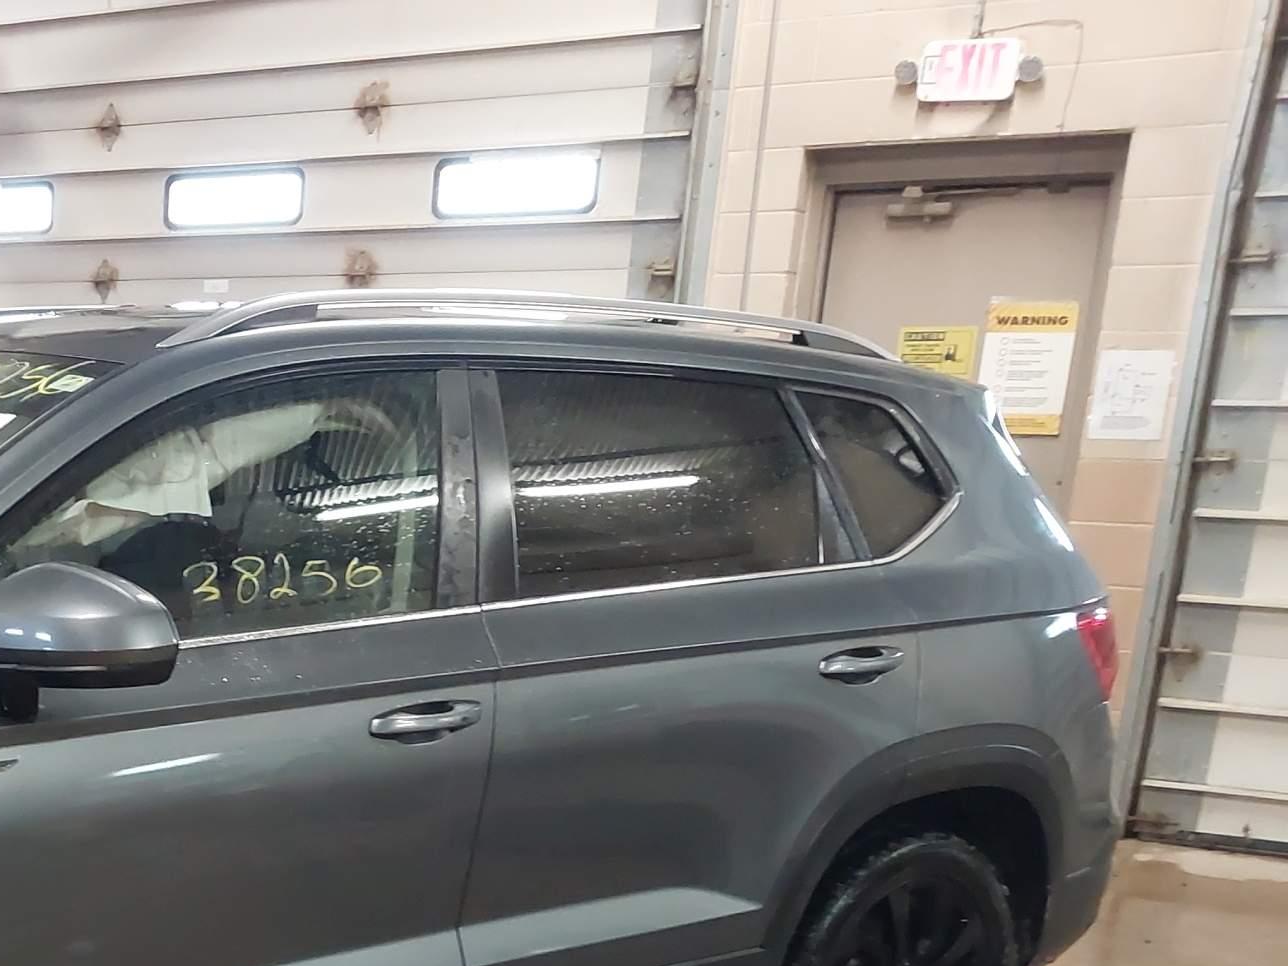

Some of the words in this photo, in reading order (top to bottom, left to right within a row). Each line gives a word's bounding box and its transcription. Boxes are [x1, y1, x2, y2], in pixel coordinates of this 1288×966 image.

[935, 42, 1008, 92] EXIT
[996, 315, 1069, 326] WARNING
[182, 553, 383, 604] 38256
